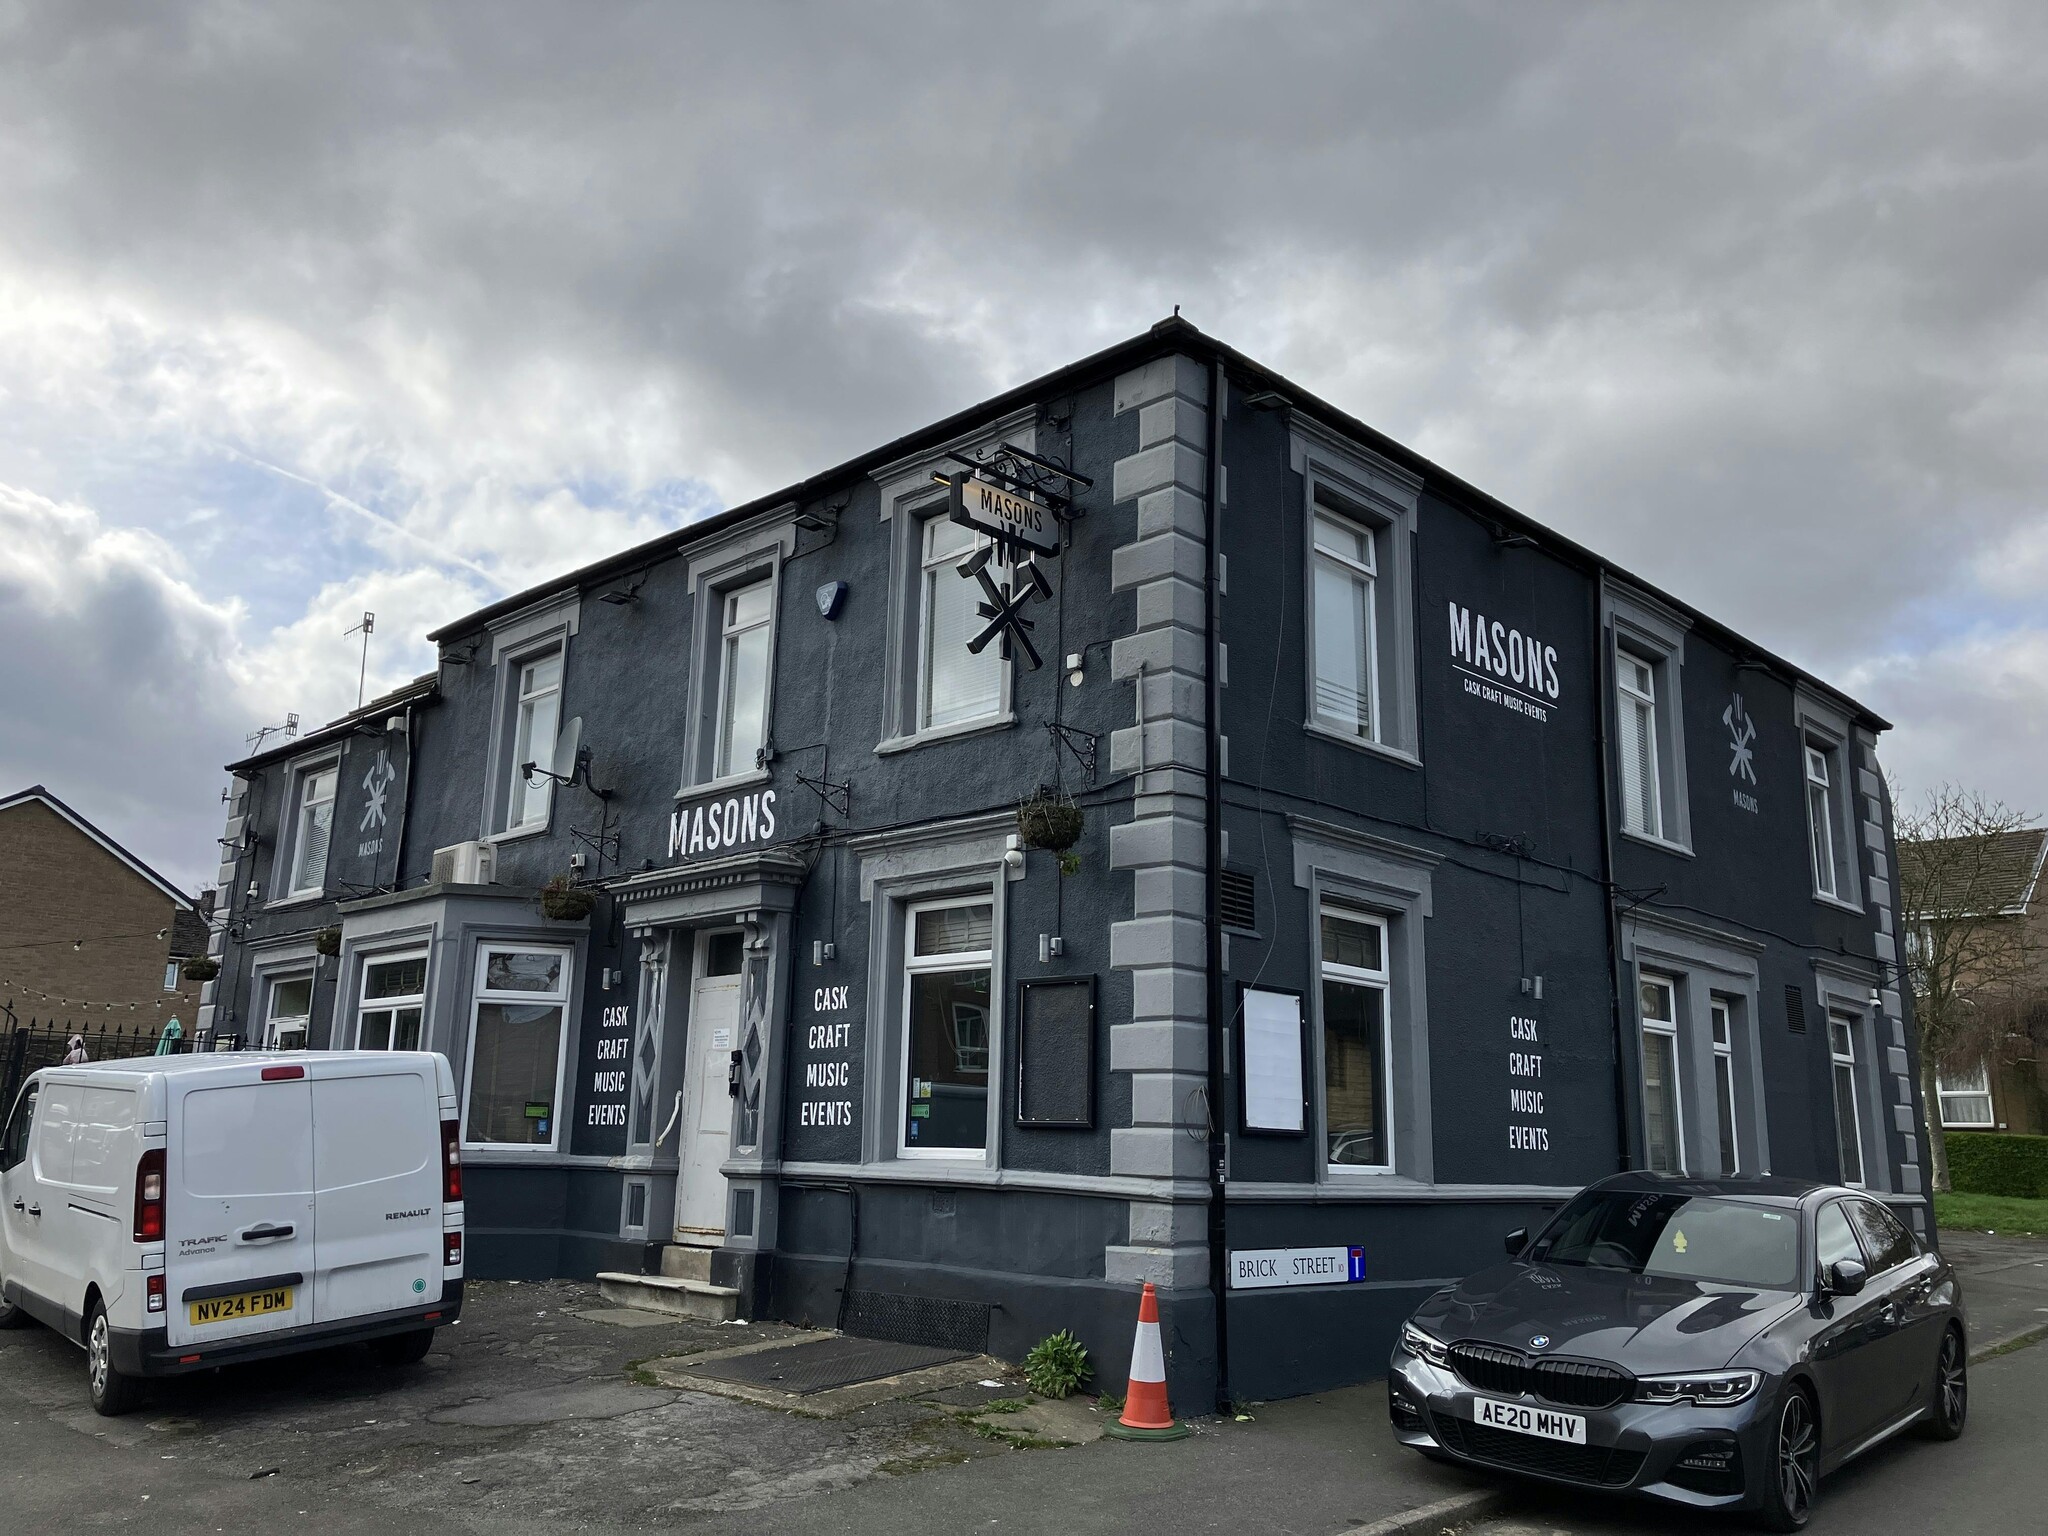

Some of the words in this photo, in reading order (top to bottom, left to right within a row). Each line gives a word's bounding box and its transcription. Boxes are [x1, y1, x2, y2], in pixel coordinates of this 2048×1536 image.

[981, 488, 1042, 532] MASONS
[1449, 601, 1559, 699] MASONS
[1464, 678, 1481, 697] CASK
[1482, 685, 1502, 705] CRAFT
[1503, 693, 1523, 713] MUSIC
[1524, 702, 1547, 723] EVENTS
[1733, 789, 1758, 814] MASONS
[668, 790, 776, 858] MASONS
[814, 985, 849, 1012] CASK
[602, 1005, 629, 1028] CASK
[1510, 1016, 1538, 1042] CASK
[597, 1038, 629, 1060] CRAFT
[808, 1023, 851, 1049] CRAFT
[806, 1061, 849, 1087] MUSIC
[1509, 1052, 1542, 1078] CRAFT
[593, 1071, 625, 1092] MUSIC
[800, 1101, 852, 1126] EVENTS
[1510, 1088, 1544, 1114] MUSIC
[588, 1104, 626, 1125] EVENTS
[1509, 1125, 1549, 1151] EVENTS
[385, 1208, 431, 1220] RENAULT
[178, 1234, 228, 1247] TRAFIC
[178, 1246, 216, 1257] Advance
[1239, 1259, 1278, 1278] BRICK
[1293, 1256, 1336, 1275] STREET
[198, 1298, 246, 1321] NV24
[250, 1291, 286, 1312] FDM
[1482, 1402, 1531, 1430] AE20
[1537, 1412, 1577, 1438] MHV
